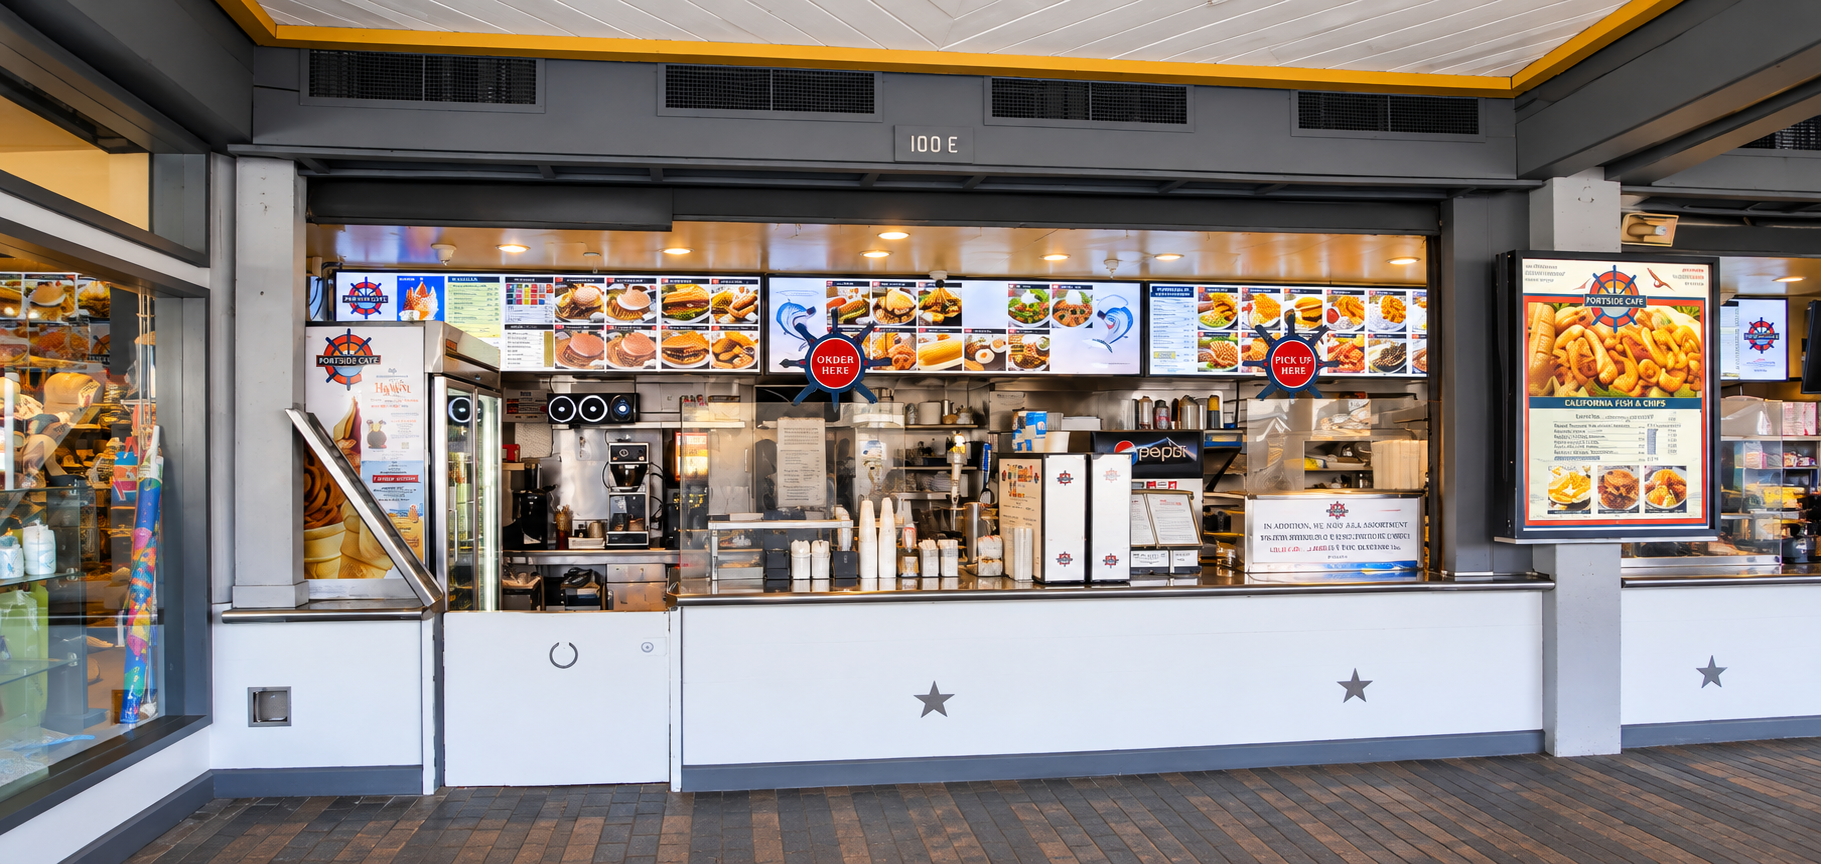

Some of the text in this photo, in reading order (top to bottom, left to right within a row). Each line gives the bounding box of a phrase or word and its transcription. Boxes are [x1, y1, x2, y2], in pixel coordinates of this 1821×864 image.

[911, 135, 958, 154] 100 E
[1275, 356, 1297, 365] PICK
[822, 366, 849, 375] HERE
[1281, 366, 1307, 375] HERE
[1564, 399, 1613, 407] CALIFORNIA
[1615, 399, 1633, 407] FISH
[1643, 399, 1666, 407] CHIPS
[1263, 522, 1272, 530] IN
